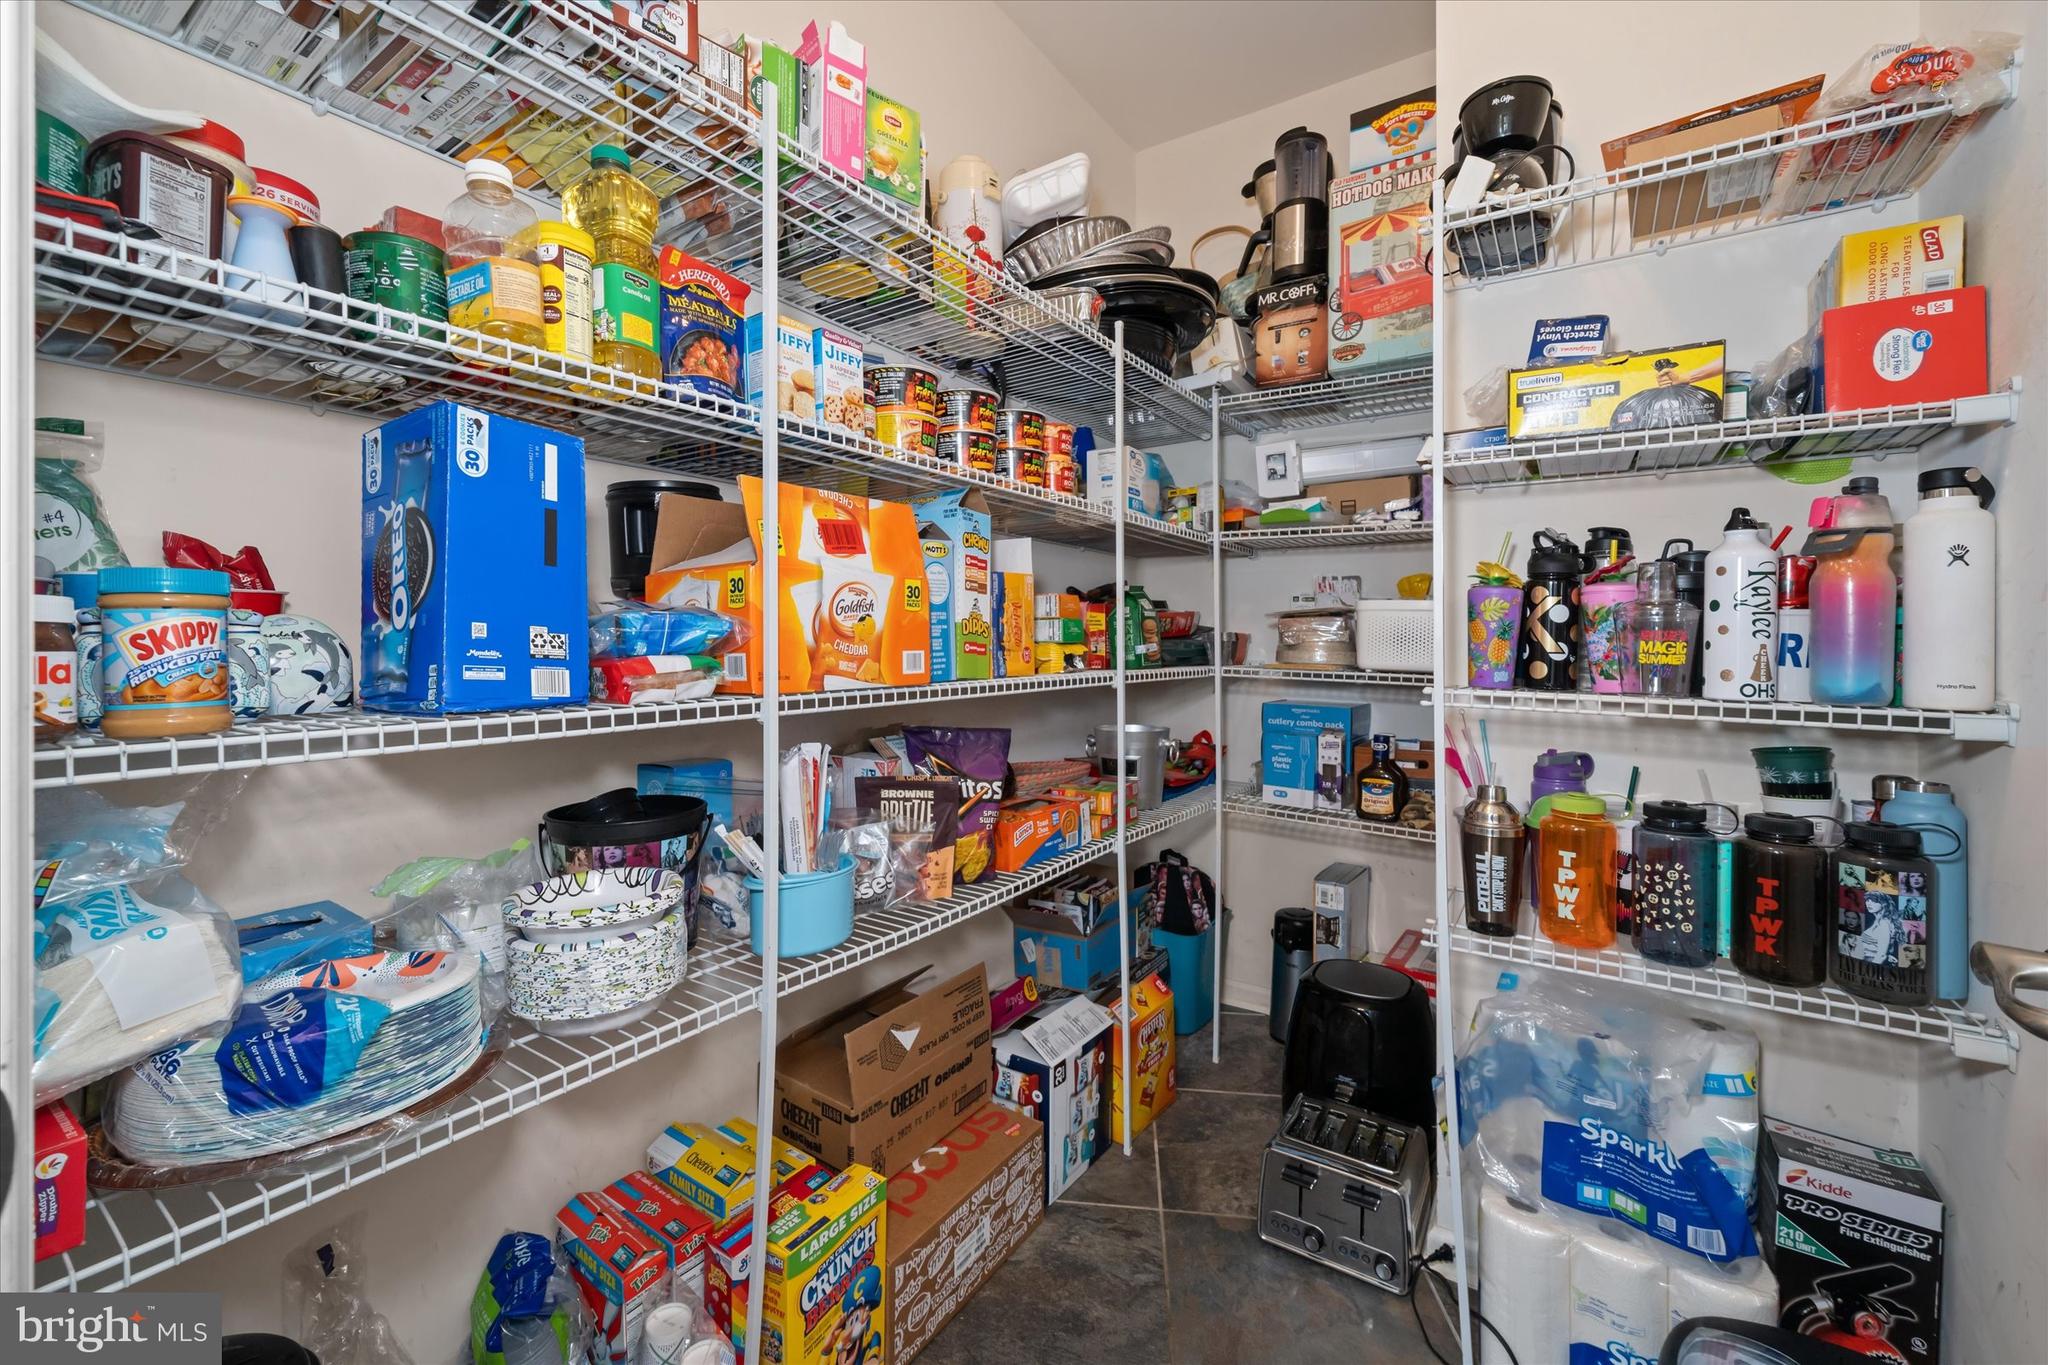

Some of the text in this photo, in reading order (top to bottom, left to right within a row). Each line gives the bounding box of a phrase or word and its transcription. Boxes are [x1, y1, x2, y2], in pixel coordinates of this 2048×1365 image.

[1372, 102, 1436, 130] SUPERPRETZE
[150, 157, 183, 174] Nutrition
[149, 175, 181, 194] Calories
[1332, 177, 1393, 208] HOTDOG
[279, 194, 319, 219] SERVING
[1922, 229, 1940, 261] GLAD
[1867, 242, 1877, 302] ODOR CONTRO
[1891, 261, 1900, 279] FOR
[1902, 235, 1912, 297] STEADYRELEAS
[476, 278, 487, 290] OIL
[622, 286, 644, 299] Canola
[677, 268, 731, 303] HEREFORD
[1258, 290, 1278, 306] MR.
[1933, 301, 1946, 312] 30
[667, 294, 737, 330] MEATBALLS
[1536, 331, 1600, 343] Stretch Vinyl
[1539, 322, 1602, 334] Exam Gloves
[824, 344, 862, 369] JIFFY
[1890, 334, 1901, 376] Strong Flex
[1522, 384, 1615, 404] CONTRACTOR
[464, 415, 480, 473] 30 PACKS
[369, 469, 379, 491] 30
[818, 488, 855, 509] CHEDDAR
[42, 509, 65, 523] #4
[962, 531, 990, 554] CHEWY
[391, 502, 410, 632] OREO
[729, 577, 745, 594] 30
[906, 585, 921, 599] 30
[834, 597, 875, 622] Goldfish
[961, 617, 990, 638] DIPPS
[128, 620, 218, 661] SKIPPY
[833, 639, 869, 656] CHEDDAR
[1639, 641, 1688, 655] MAGIC
[130, 650, 222, 688] REDUCED FAT
[1638, 653, 1686, 666] SUMMER
[1760, 648, 1768, 683] CHEER
[165, 666, 195, 682] CREAMY
[1739, 683, 1776, 700] OHS
[1936, 683, 1957, 691] Hydro
[1268, 717, 1345, 729] cutlery combo pack
[1272, 756, 1292, 764] plastic
[1273, 762, 1290, 770] forks
[881, 789, 935, 799] BROWNIE
[1476, 851, 1490, 913] PITBULL
[334, 995, 358, 1017] 2X
[952, 999, 985, 1022] FRAGILE
[971, 1010, 986, 1025] KEEP
[918, 1037, 937, 1056] PLACE
[937, 1030, 949, 1042] DRY
[158, 1049, 182, 1077] 86
[251, 1044, 272, 1083] CUT RESISTANT
[266, 1038, 287, 1079] MICROWAVABLE
[150, 1058, 174, 1085] PLATE
[1791, 1130, 1917, 1168] Kidde 210
[685, 1151, 714, 1177] Cheerios
[669, 1169, 697, 1198] FAMILY
[697, 1187, 715, 1210] SIZE
[1650, 1172, 1676, 1185] CHOICE
[1806, 1176, 1853, 1199] Kidde
[36, 1189, 48, 1224] Zipper
[44, 1186, 57, 1224] Double
[636, 1199, 661, 1216] Trix
[776, 1216, 802, 1236] SIZE
[800, 1219, 848, 1262] LARGE
[849, 1191, 878, 1222] SIZE
[1784, 1193, 1933, 1249] PRO SERIES
[680, 1232, 706, 1258] Trix
[1779, 1226, 1804, 1243] 210
[1839, 1225, 1933, 1262] Fire Extinguisher
[1795, 1240, 1817, 1255] UNIT
[801, 1219, 878, 1312] CRUNCH
[599, 1271, 616, 1290] SIZE
[630, 1264, 658, 1292] Trix
